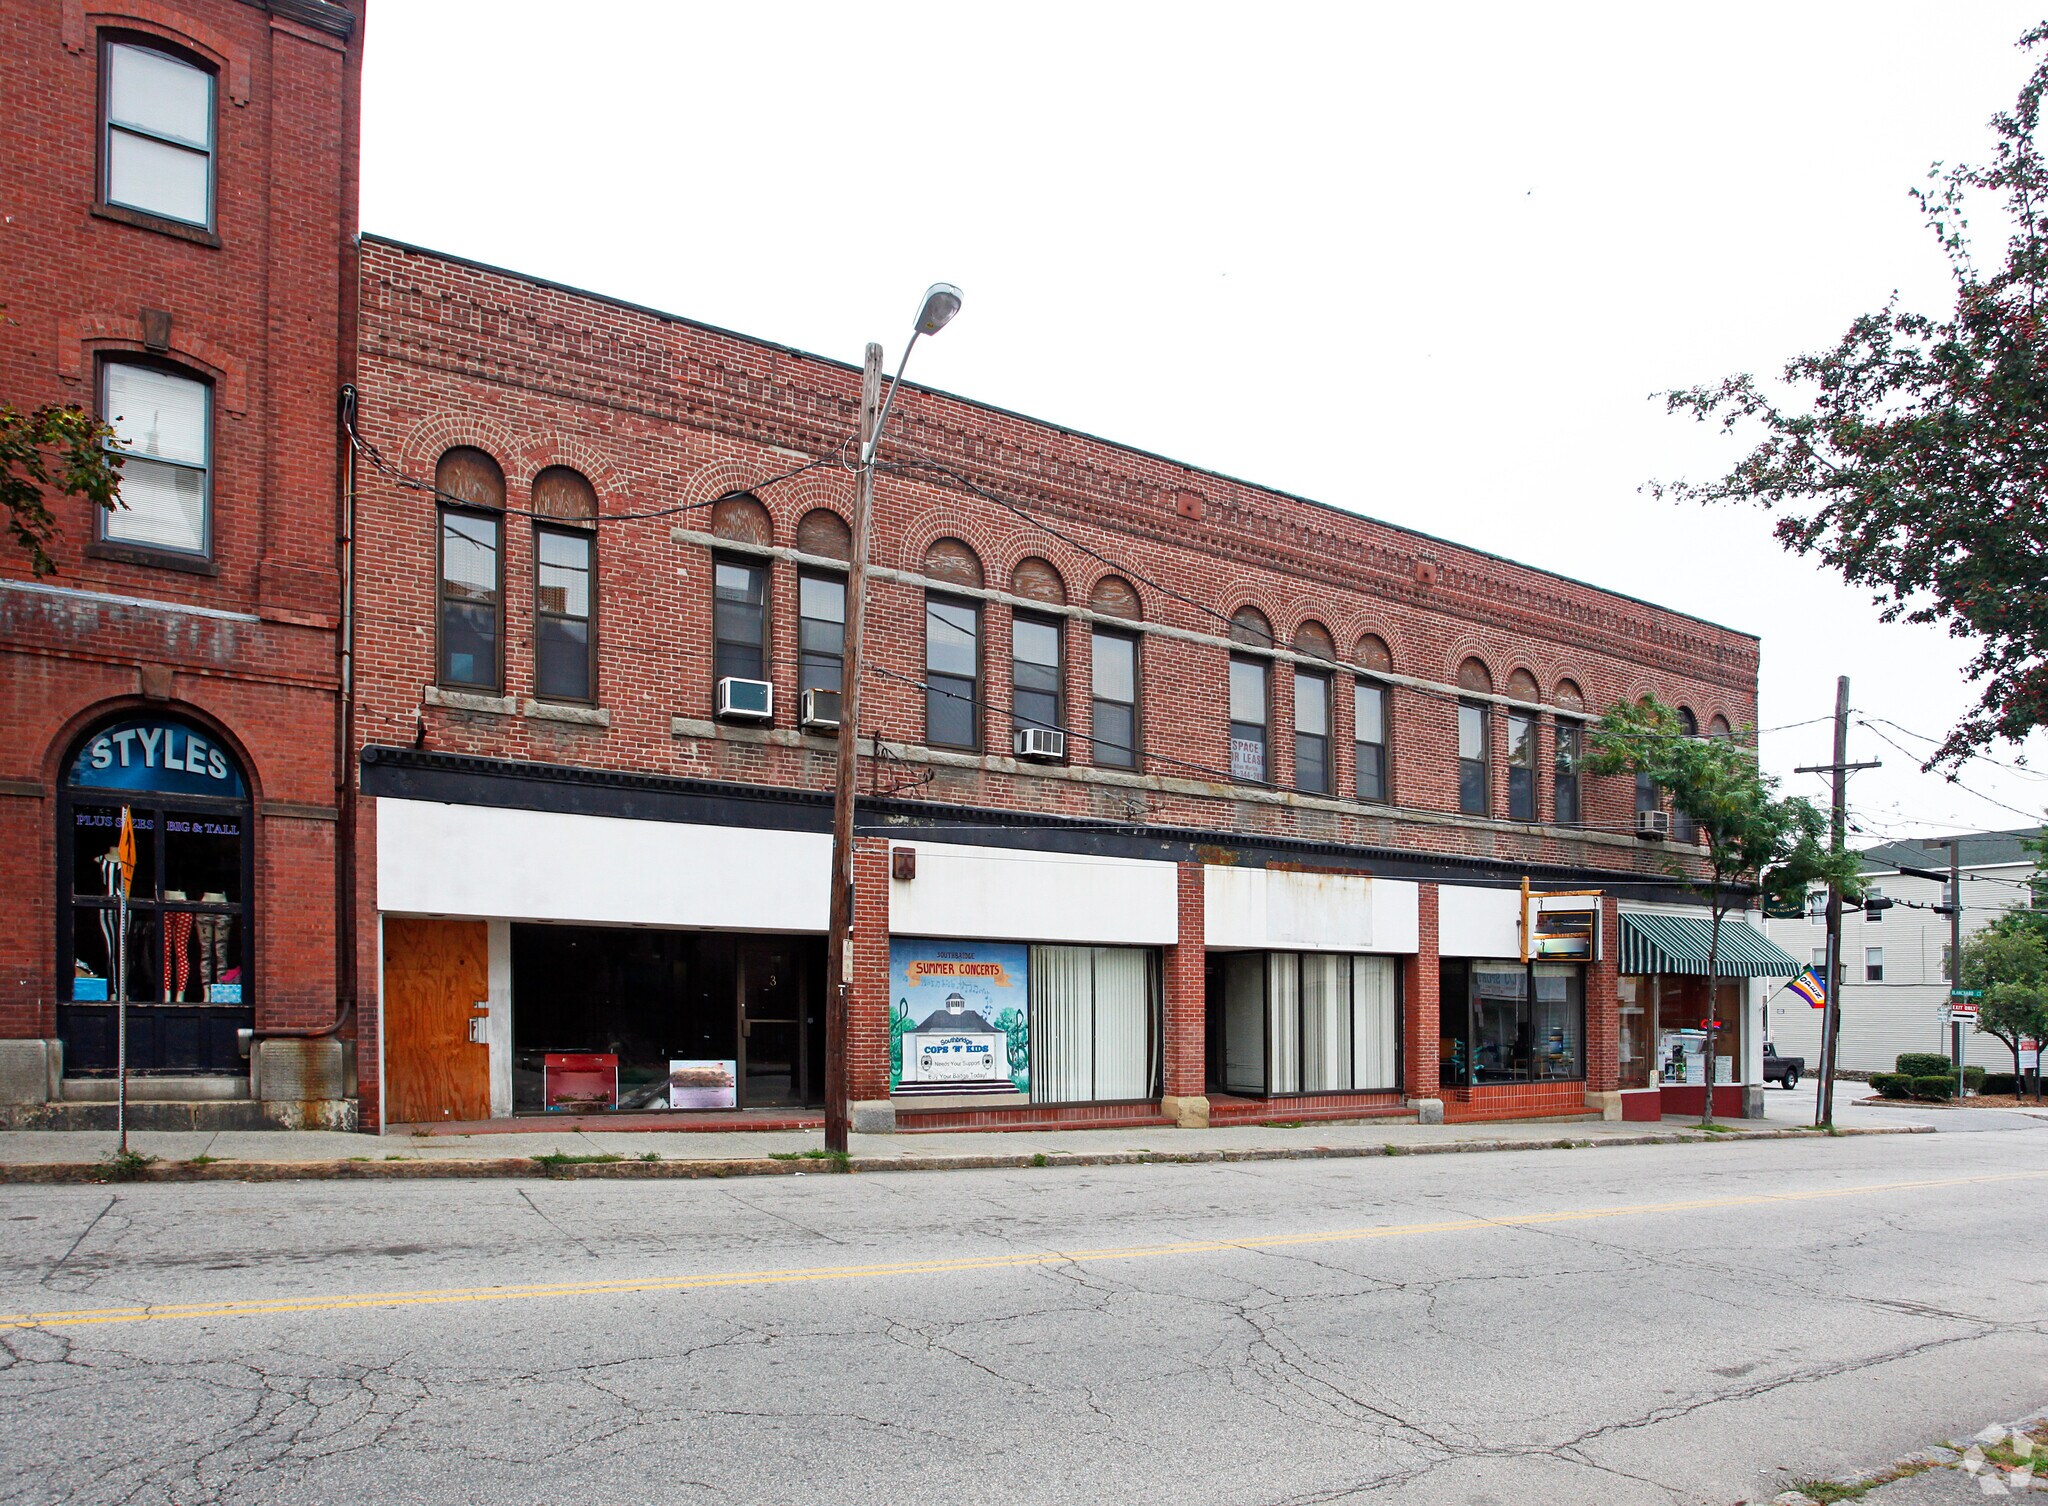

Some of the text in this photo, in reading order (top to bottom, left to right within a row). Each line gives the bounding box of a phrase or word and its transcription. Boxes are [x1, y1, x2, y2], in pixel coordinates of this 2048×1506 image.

[90, 728, 228, 780] STYLES
[1232, 740, 1259, 754] SPACE
[1231, 752, 1265, 766] OR LEASE
[76, 815, 154, 830] PLUS SZES
[167, 820, 240, 836] BIG & TALL
[936, 951, 976, 960] SOUTHBRIDGE
[916, 962, 1000, 976] SUMMER CONCERTS
[769, 974, 777, 987] 3
[1799, 976, 1823, 999] OPEN
[940, 1036, 973, 1046] Southbridge
[924, 1045, 949, 1054] COPS
[966, 1045, 989, 1053] KIDS
[963, 1060, 981, 1068] Support
